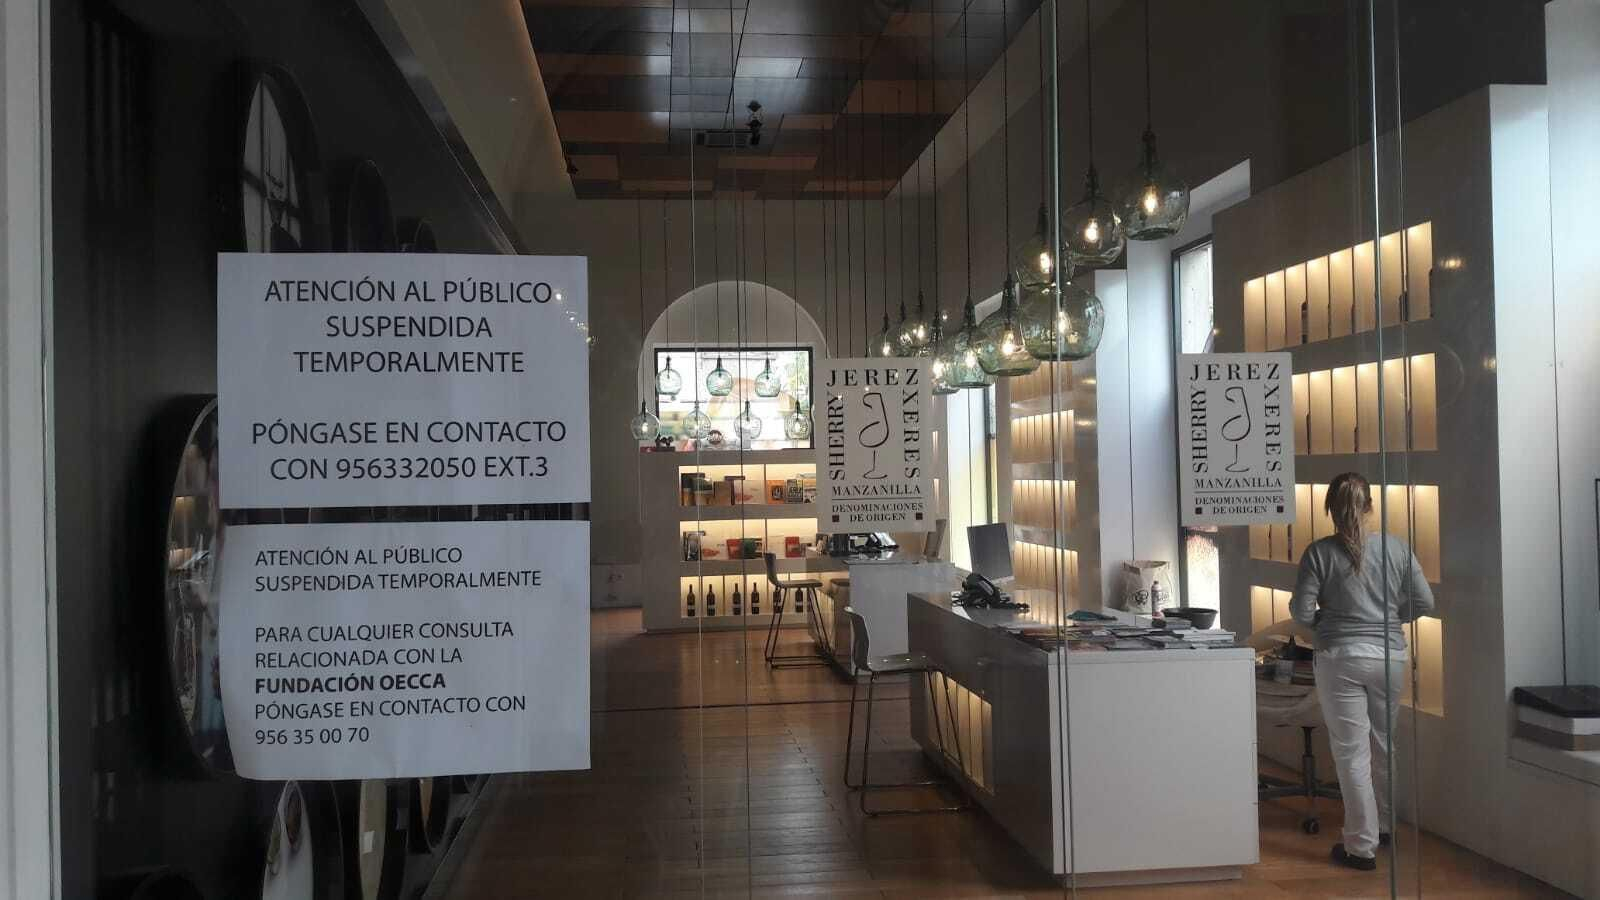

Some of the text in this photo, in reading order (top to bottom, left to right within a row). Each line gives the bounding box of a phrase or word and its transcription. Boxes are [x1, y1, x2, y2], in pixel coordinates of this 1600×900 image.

[264, 275, 553, 304] ATENCIÓN AL PÚBLICO
[325, 315, 493, 339] SUSPENDIDA
[292, 350, 525, 374] TEMPORALMENTE
[1190, 363, 1280, 381] JEREZ
[826, 368, 919, 387] JEREZ
[252, 417, 567, 445] PÓNGASE EN CONTACTO
[827, 391, 846, 481] SHERRY
[902, 389, 921, 479] XERES
[1190, 385, 1208, 473] SHERRY
[1264, 384, 1282, 472] XERES
[269, 455, 549, 481] CON 956332050 EXT.3
[832, 484, 921, 496] MANZANILLA
[1194, 477, 1282, 489] MANZANILLA
[832, 502, 924, 513] DENOMINACIONES
[1195, 496, 1284, 505] DENOMINACIONES
[1213, 505, 1268, 514] DE ORIGEN
[850, 513, 906, 522] DE ORIGEN
[254, 544, 463, 567] ATENCIÓN AL PÚBLICO
[255, 569, 542, 593] SUSPENDIDA TEMPORALMENTE
[255, 621, 515, 643] PARA CUALQUIER CONSULTA
[255, 647, 464, 669] RELACIONADA CON LA
[255, 672, 447, 695] FUNDACIÓN OECCA
[255, 695, 526, 721] PÓNGASE EN CONTACTO CON
[255, 726, 370, 745] 956 35 00 70
